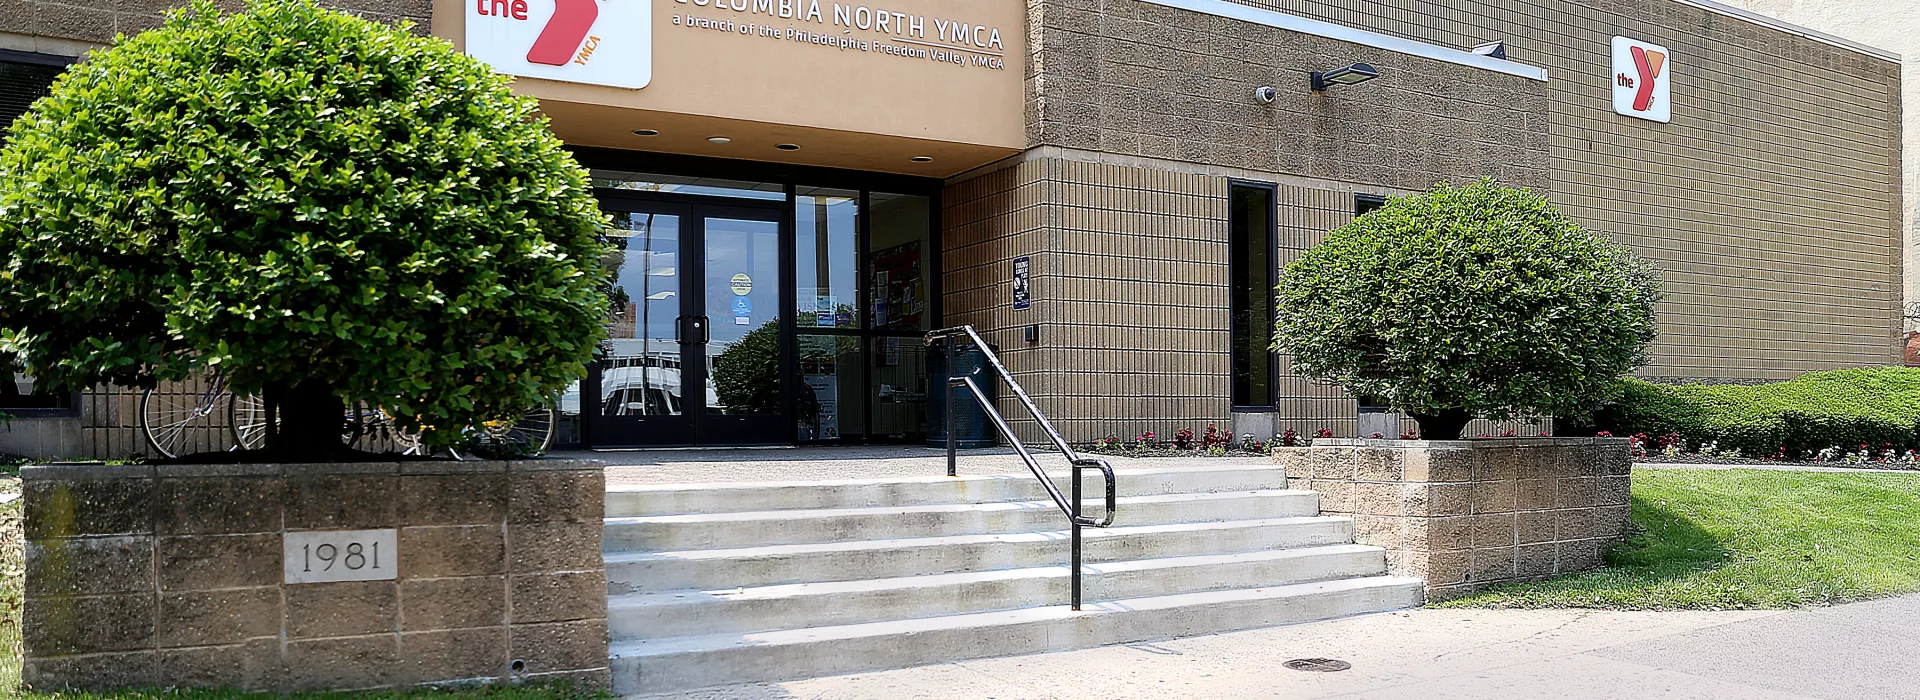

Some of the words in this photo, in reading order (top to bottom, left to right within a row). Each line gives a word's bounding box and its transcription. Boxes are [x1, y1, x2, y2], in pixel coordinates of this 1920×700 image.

[674, 0, 823, 23] UMBIA
[833, 3, 925, 38] NORTH
[934, 18, 1004, 50] YMCA
[574, 35, 601, 66] YMCA
[672, 14, 681, 25] a
[686, 14, 735, 32] branch
[739, 23, 755, 34] of
[759, 26, 781, 39] the
[786, 27, 868, 51] Philadelphia
[872, 40, 926, 59] Freedom
[929, 48, 966, 67] Valley
[970, 54, 1005, 70] YMCA
[1617, 73, 1634, 88] the
[303, 541, 380, 572] 1981
